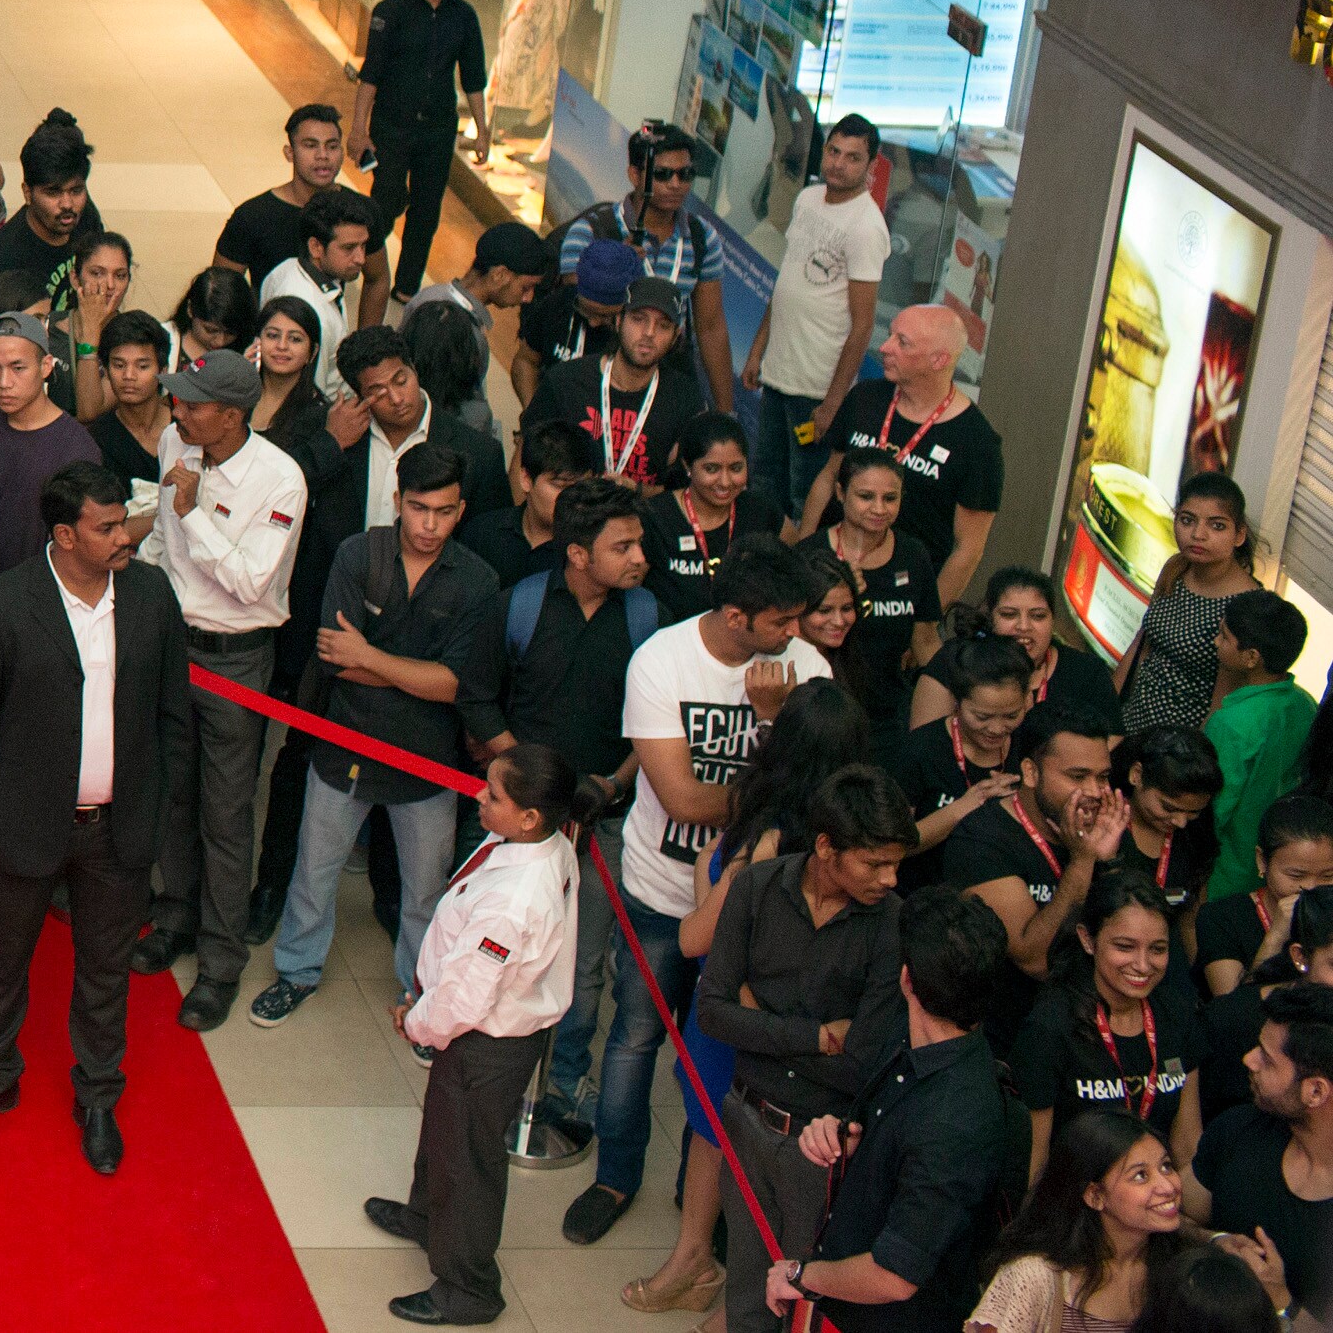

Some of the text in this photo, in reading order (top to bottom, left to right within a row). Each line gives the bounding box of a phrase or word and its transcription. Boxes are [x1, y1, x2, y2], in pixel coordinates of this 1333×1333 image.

[902, 453, 940, 480] NDIA
[669, 557, 704, 576] H&M
[874, 601, 914, 616] INDIA
[1029, 884, 1057, 903] H&
[1076, 1078, 1125, 1099] H&M
